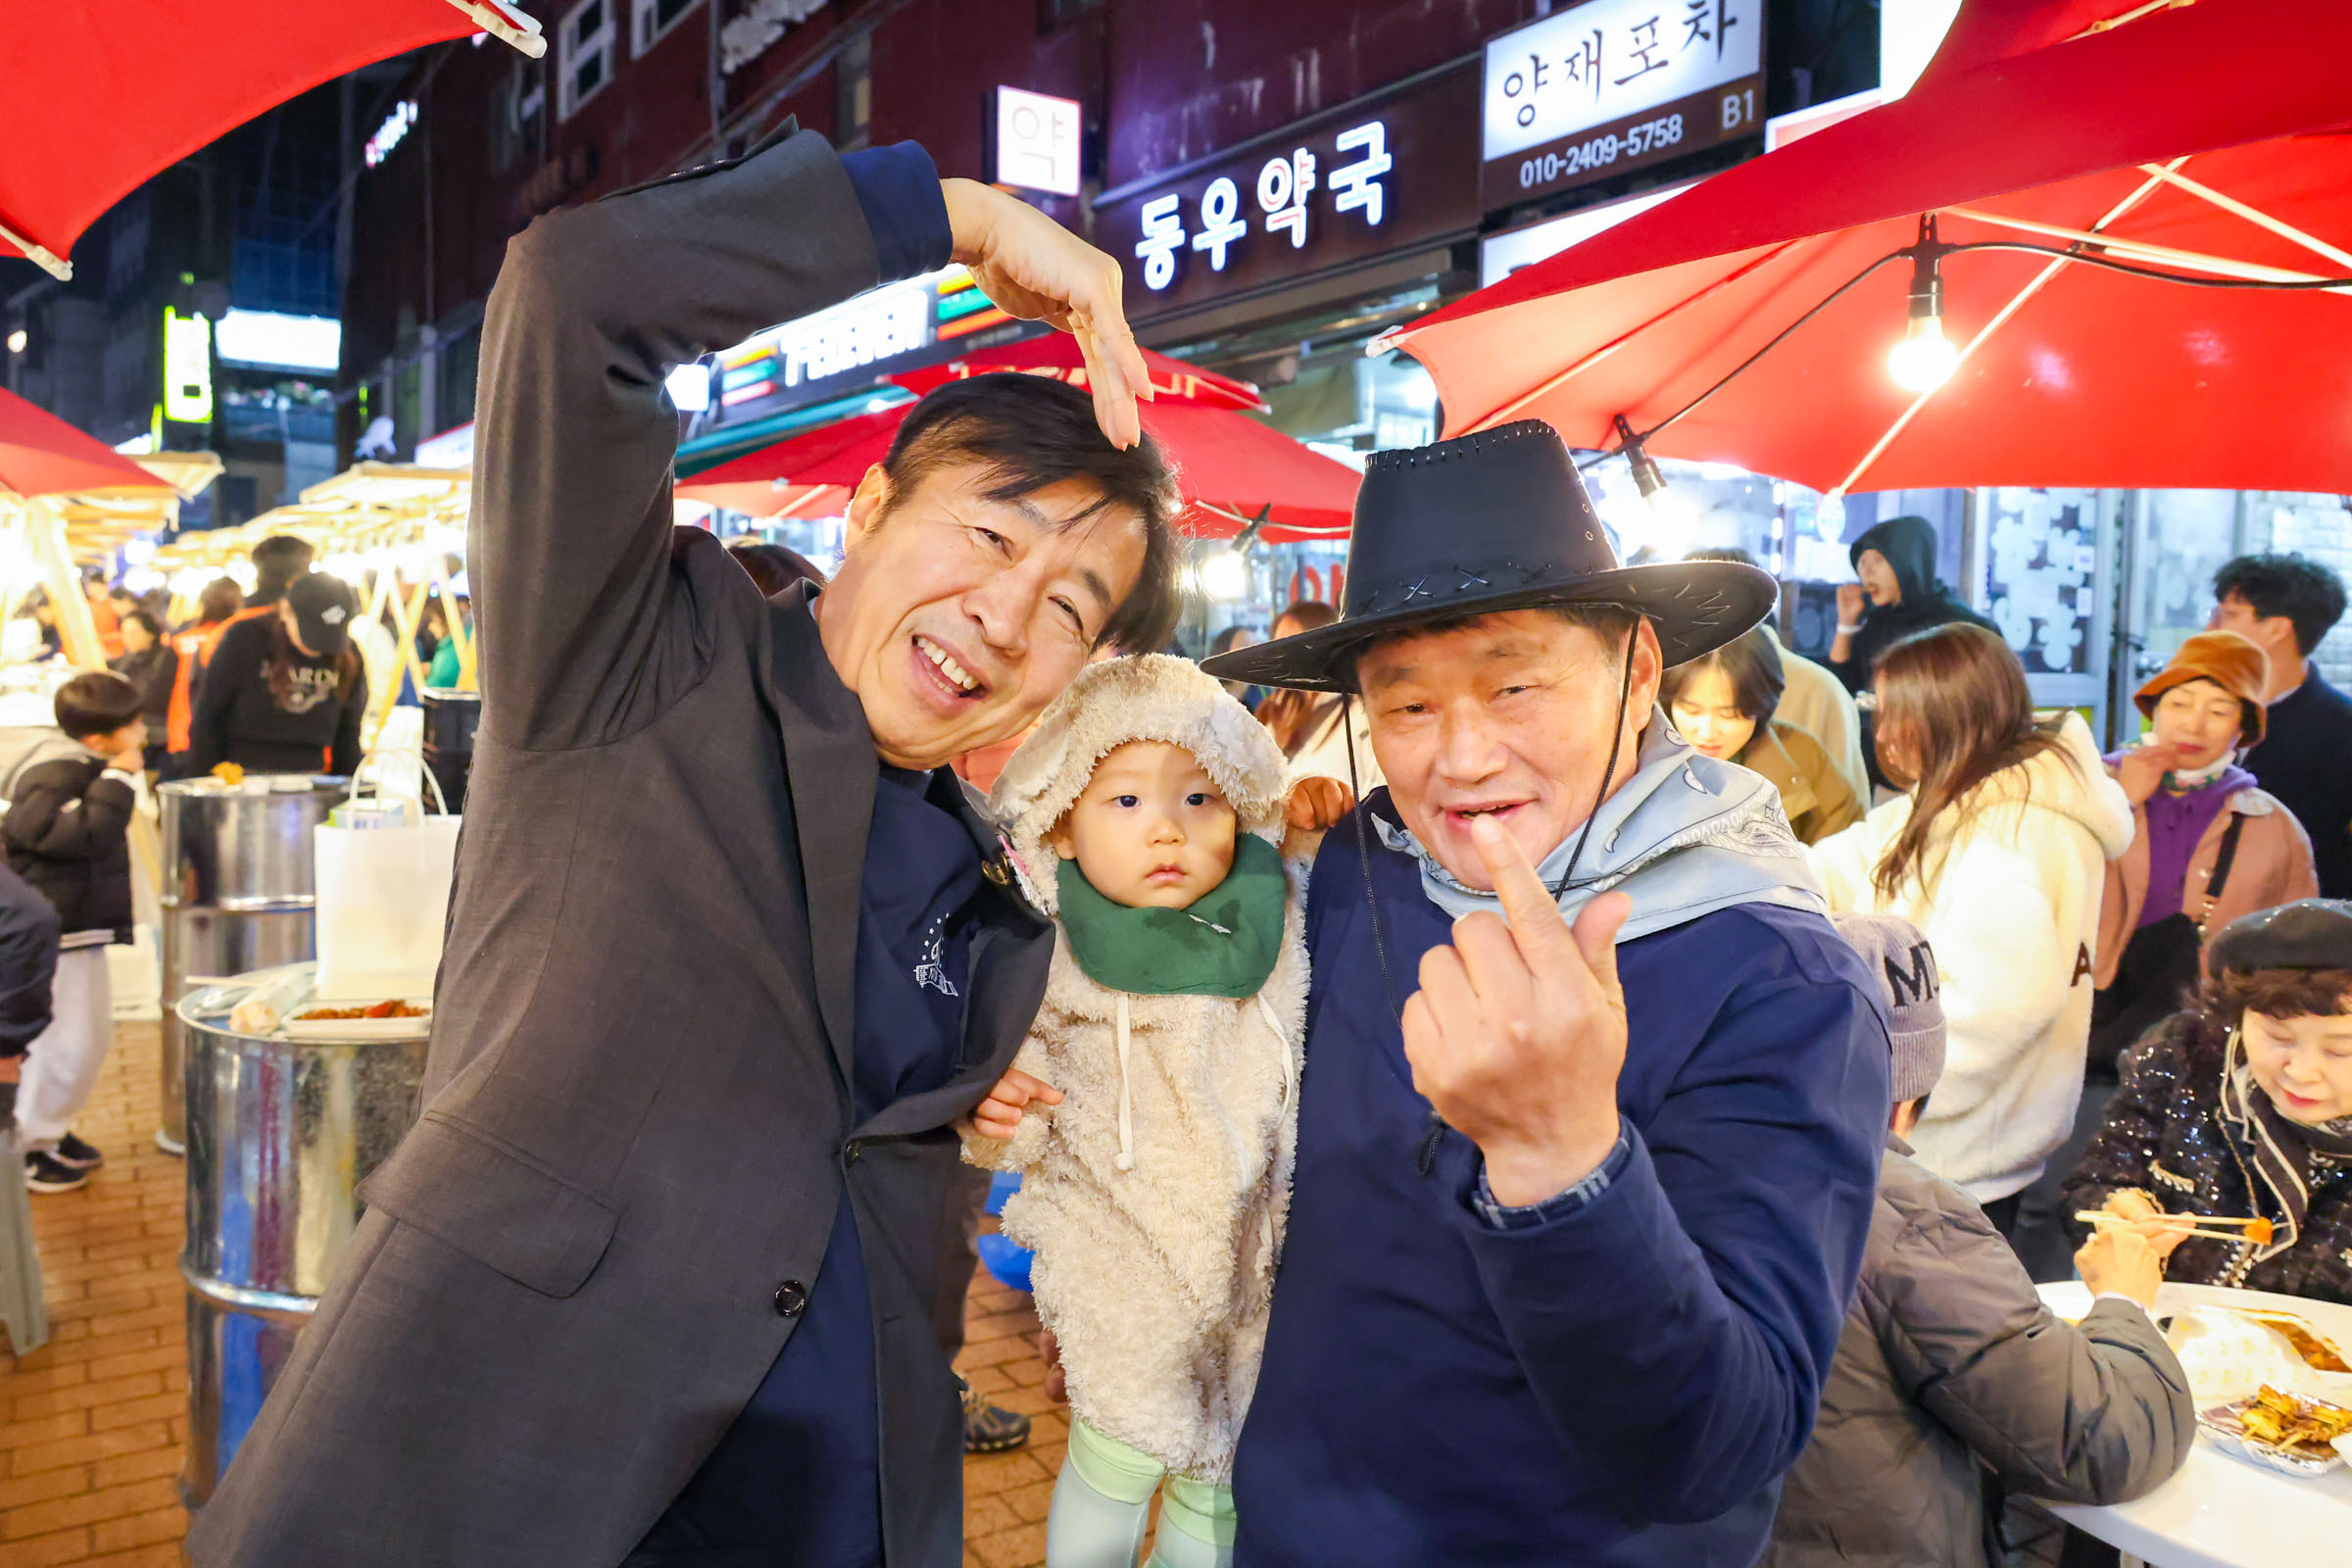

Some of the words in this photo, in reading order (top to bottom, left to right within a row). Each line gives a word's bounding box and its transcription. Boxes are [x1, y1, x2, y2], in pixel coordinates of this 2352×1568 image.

[1503, 0, 1738, 127] 양재포차
[1011, 105, 1065, 181] 약
[1722, 89, 1755, 130] B1
[1520, 113, 1684, 189] 010-2409-5758
[1135, 120, 1393, 291] 동우약국
